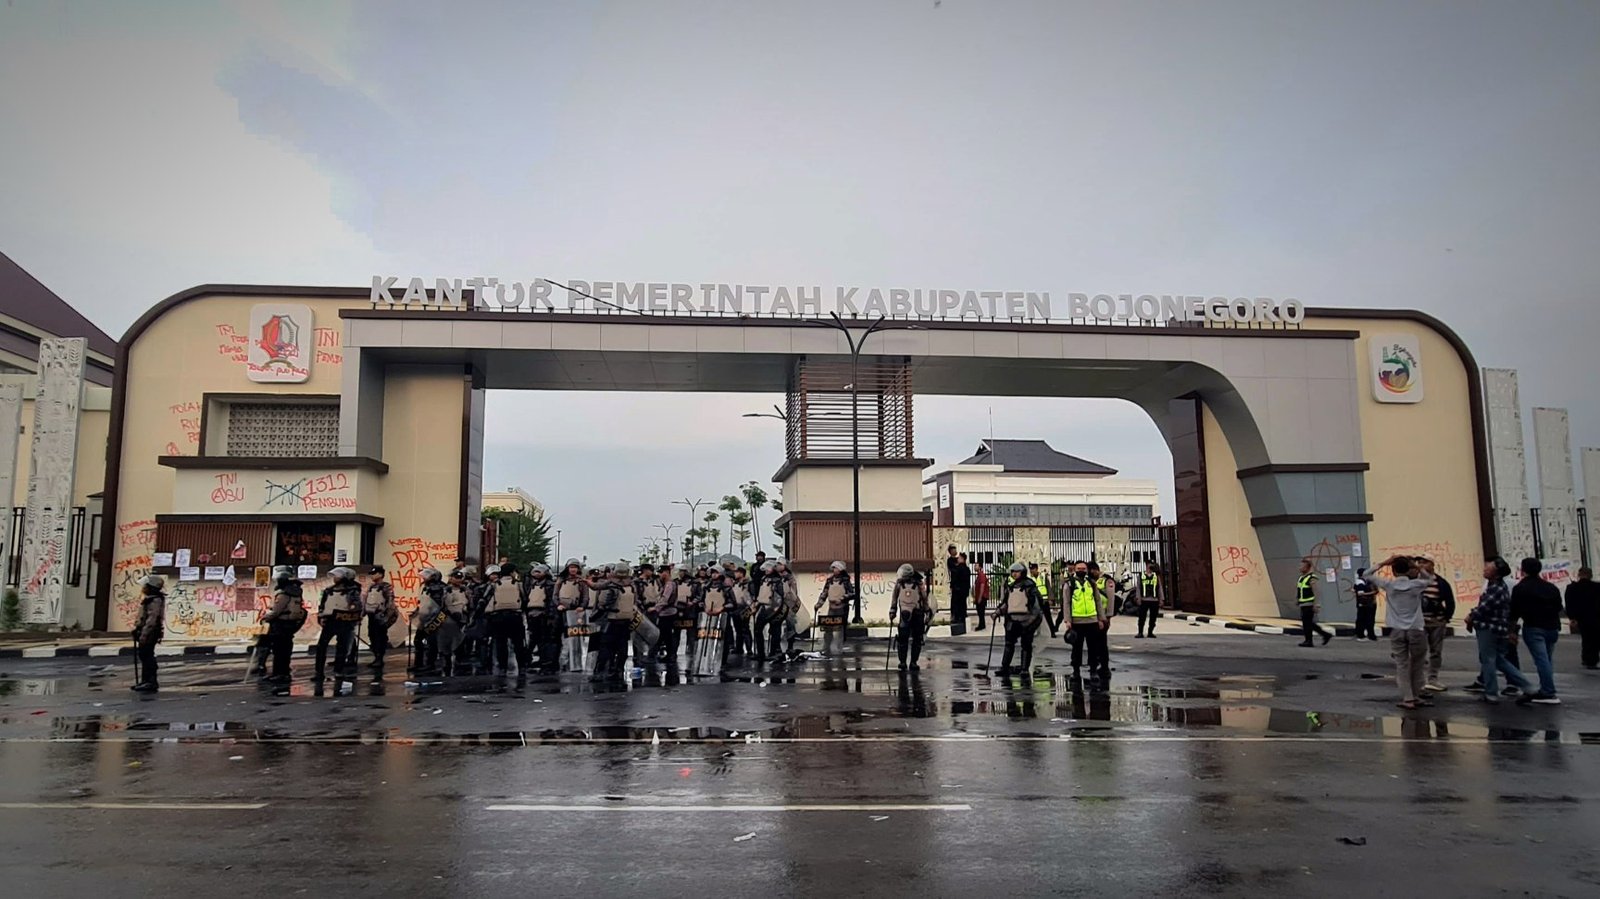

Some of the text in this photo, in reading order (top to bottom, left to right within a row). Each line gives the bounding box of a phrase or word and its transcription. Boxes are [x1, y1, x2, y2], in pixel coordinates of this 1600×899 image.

[370, 275, 1305, 324] KANTOR PEMERINTAH KABUPATEN BOJONEGORO
[314, 327, 340, 347] TNI
[215, 472, 238, 488] TNI
[305, 473, 350, 496] 1312
[392, 550, 435, 569] DPR
[1217, 546, 1253, 567] DPR
